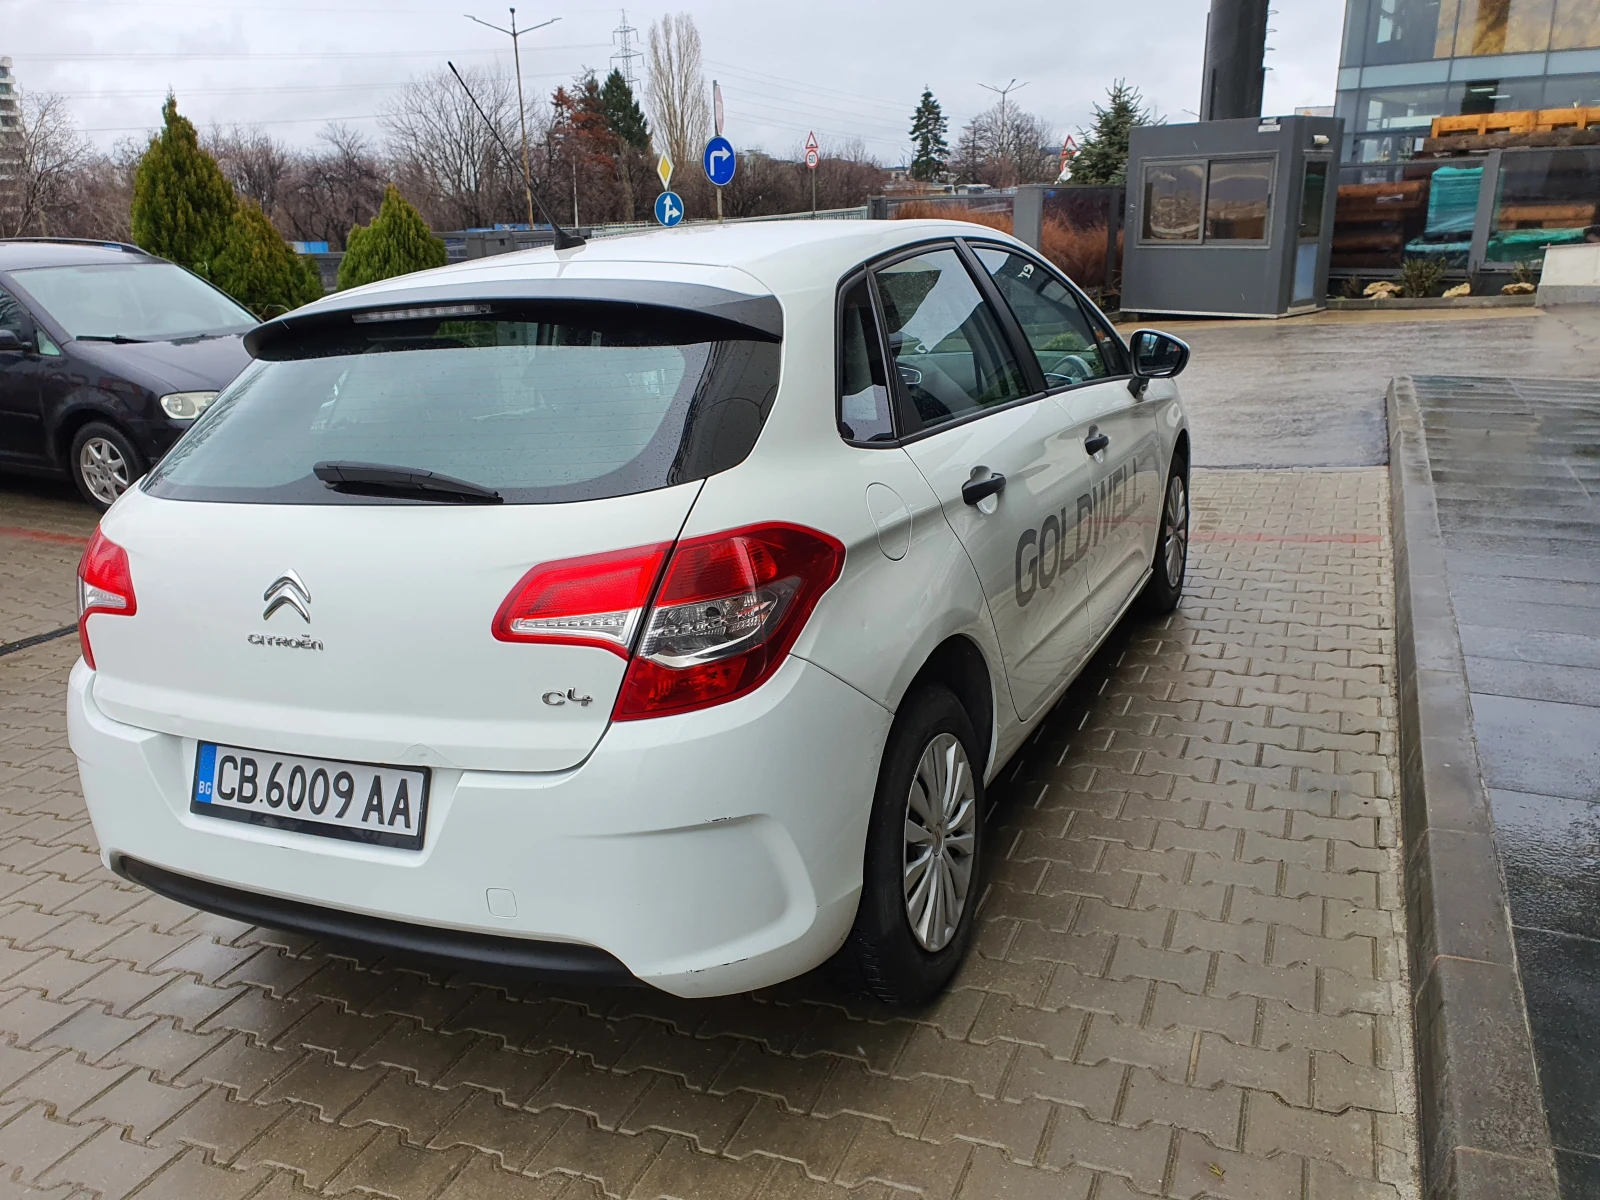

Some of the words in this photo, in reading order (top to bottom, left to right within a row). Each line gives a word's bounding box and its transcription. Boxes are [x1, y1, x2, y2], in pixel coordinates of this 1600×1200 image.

[541, 687, 593, 707] C4
[198, 780, 212, 795] BG
[361, 774, 412, 829] AA
